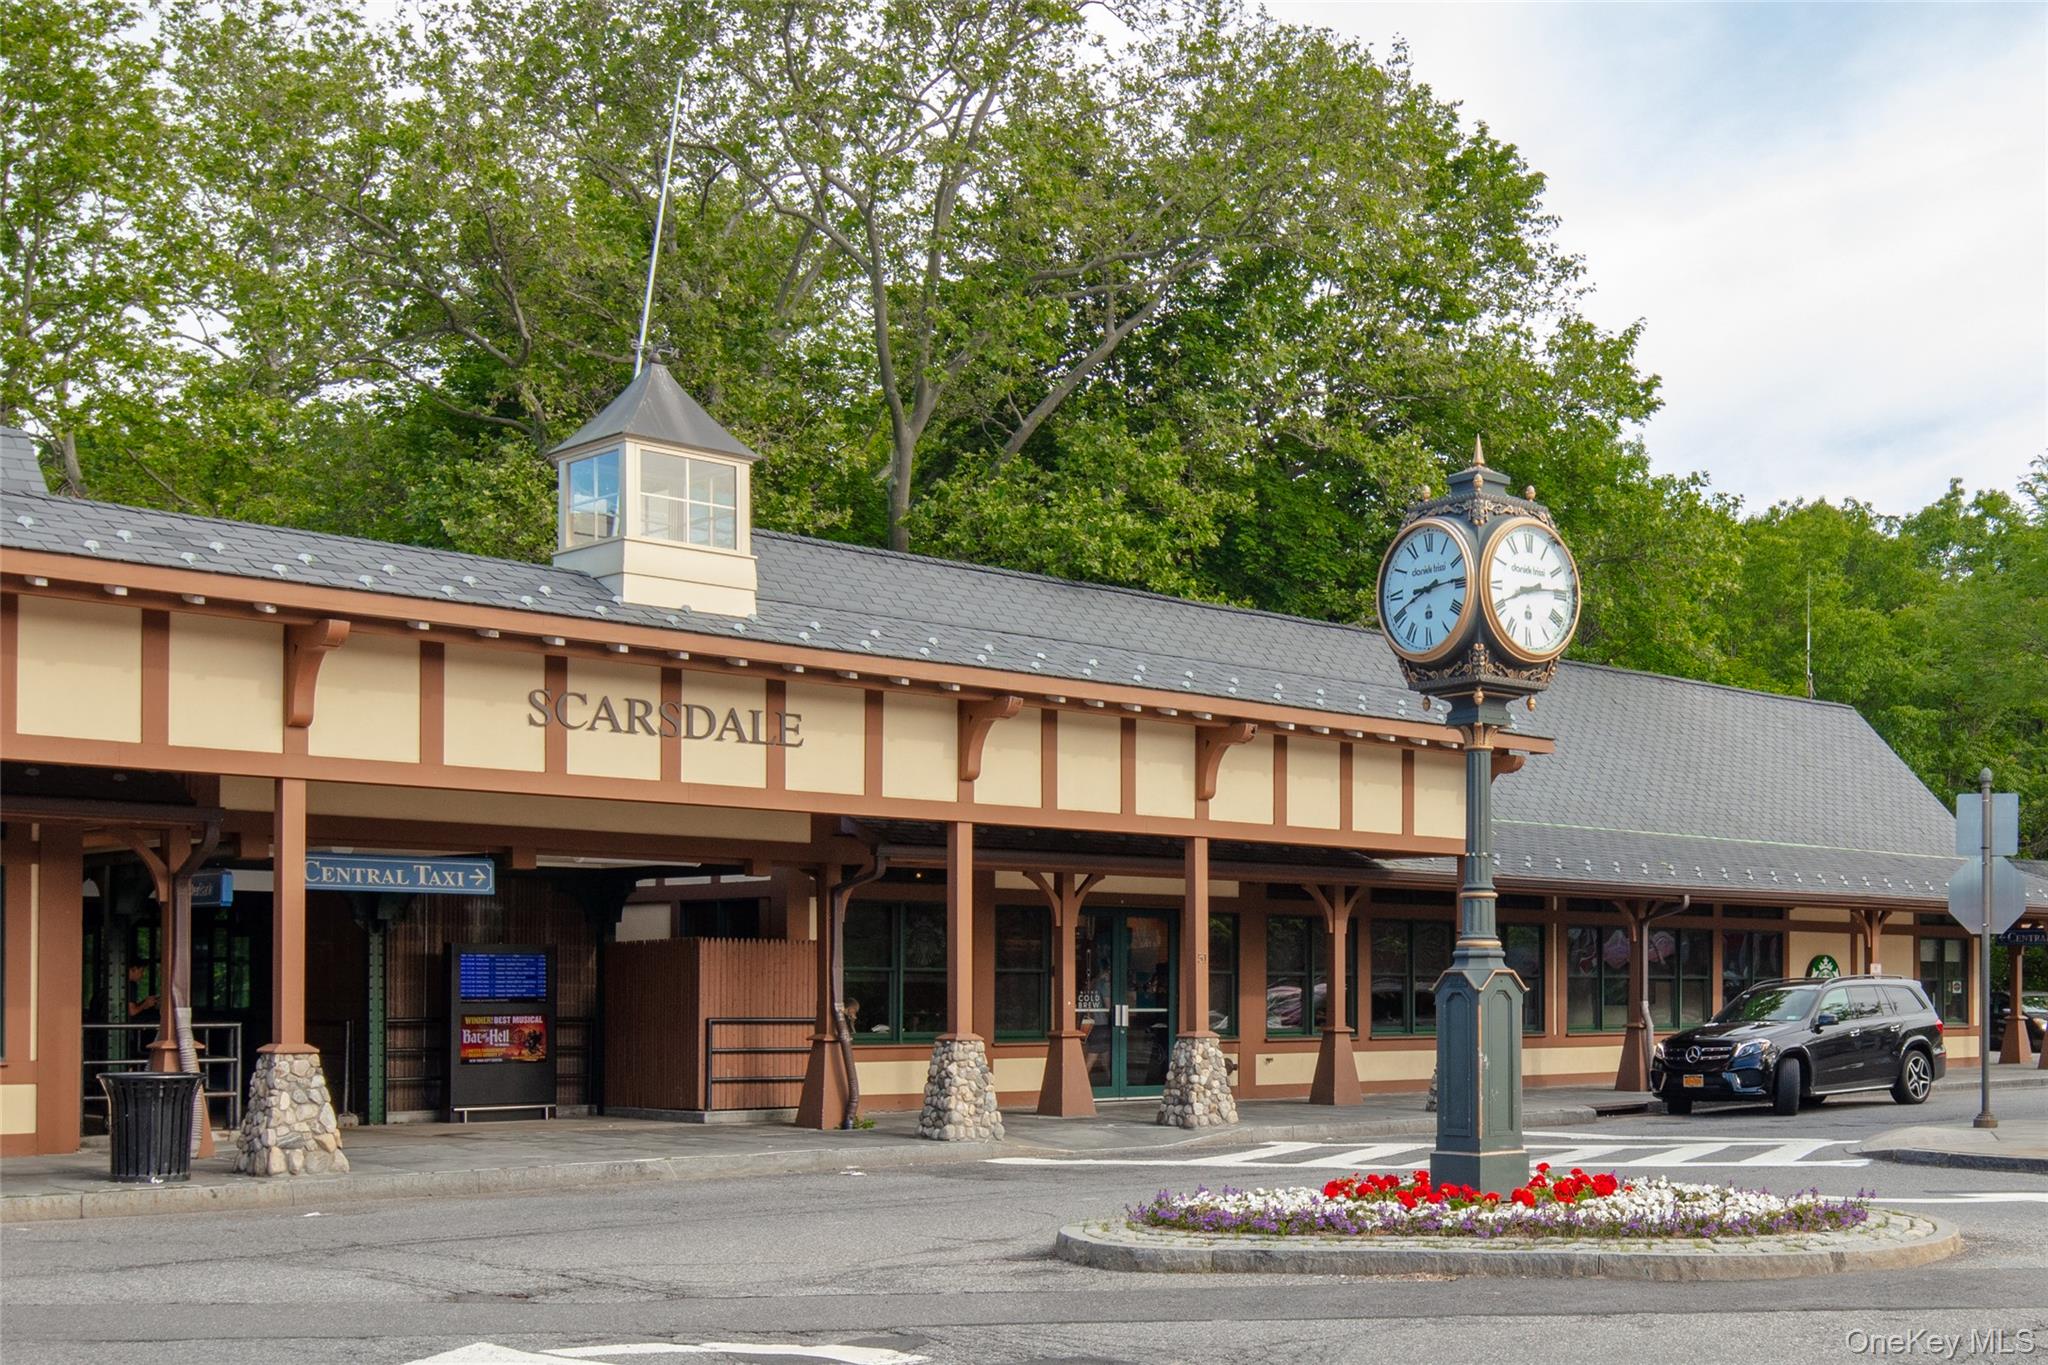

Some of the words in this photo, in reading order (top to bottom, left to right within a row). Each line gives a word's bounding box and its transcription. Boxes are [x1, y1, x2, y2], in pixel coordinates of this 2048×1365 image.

[527, 689, 803, 748] SCARSDALE
[305, 860, 409, 885] CENTRAL
[413, 864, 464, 887] TAXI
[1078, 994, 1100, 1002] COLD
[1078, 1001, 1100, 1009] BREW
[464, 1016, 493, 1025] WINNER!
[493, 1016, 511, 1024] BEST
[512, 1015, 543, 1024] MUSICAL
[489, 1028, 510, 1046] Hell
